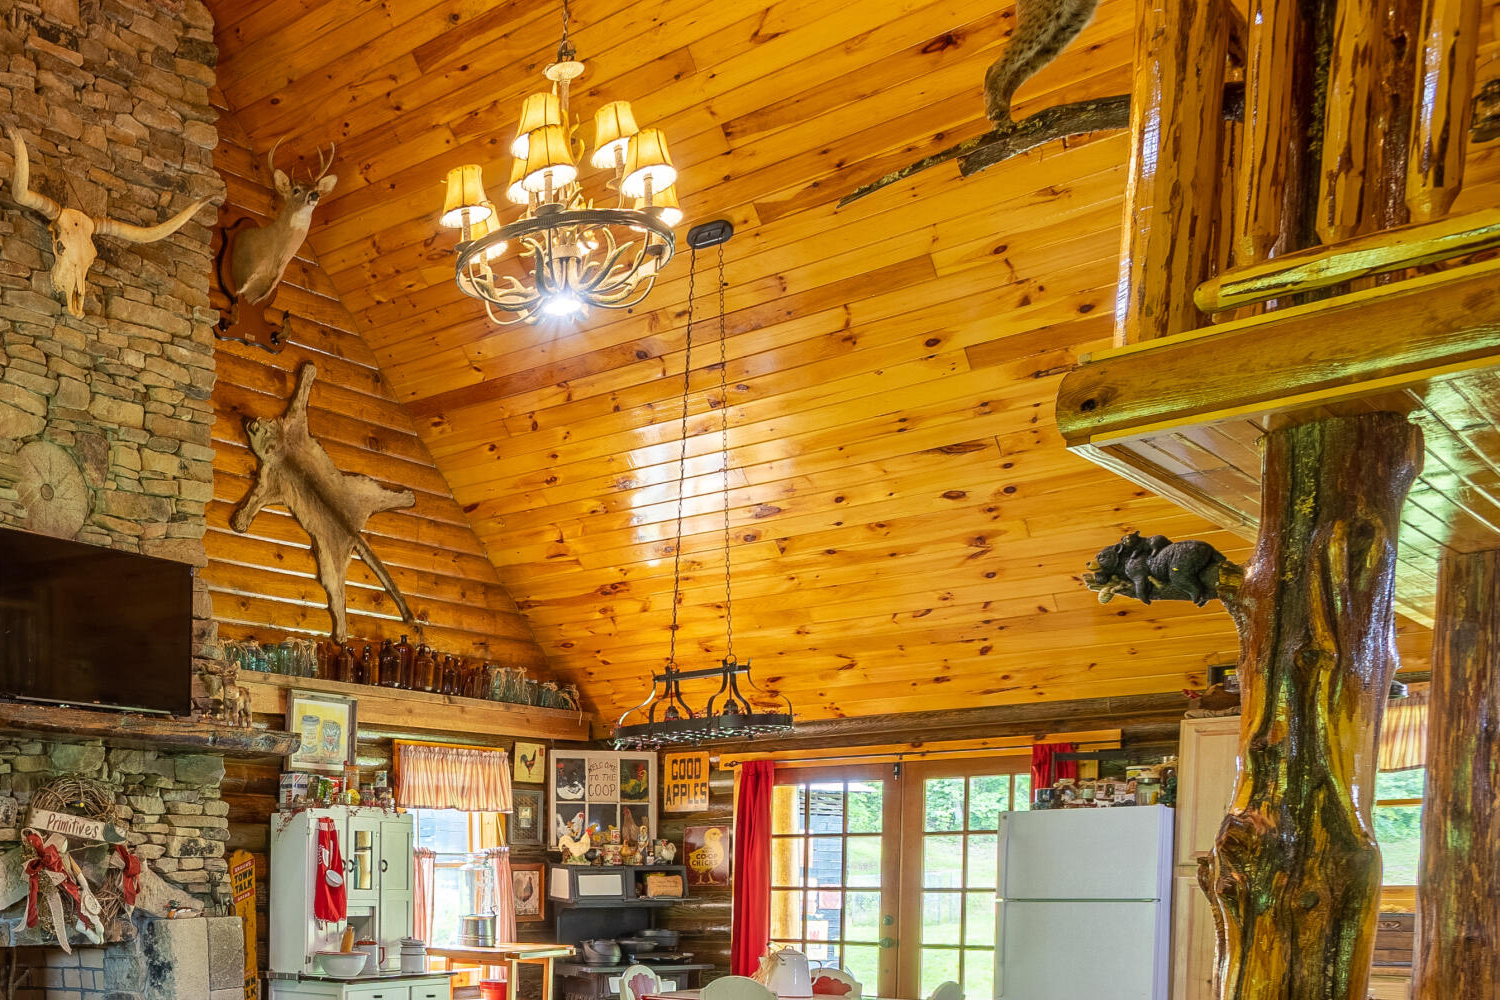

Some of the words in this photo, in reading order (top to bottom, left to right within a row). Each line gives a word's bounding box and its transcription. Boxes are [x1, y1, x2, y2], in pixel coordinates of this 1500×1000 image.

[588, 761, 618, 773] WELCOME
[671, 758, 701, 781] GOOD
[589, 773, 599, 782] TO
[602, 773, 617, 781] THE
[588, 783, 616, 797] COOP
[666, 783, 707, 806] APPLES
[46, 813, 100, 839] Primitives
[692, 859, 718, 867] CHICKS
[234, 868, 253, 885] TOWN
[234, 878, 253, 895] TALK
[245, 975, 256, 988] WN
[245, 986, 257, 1000] LK
